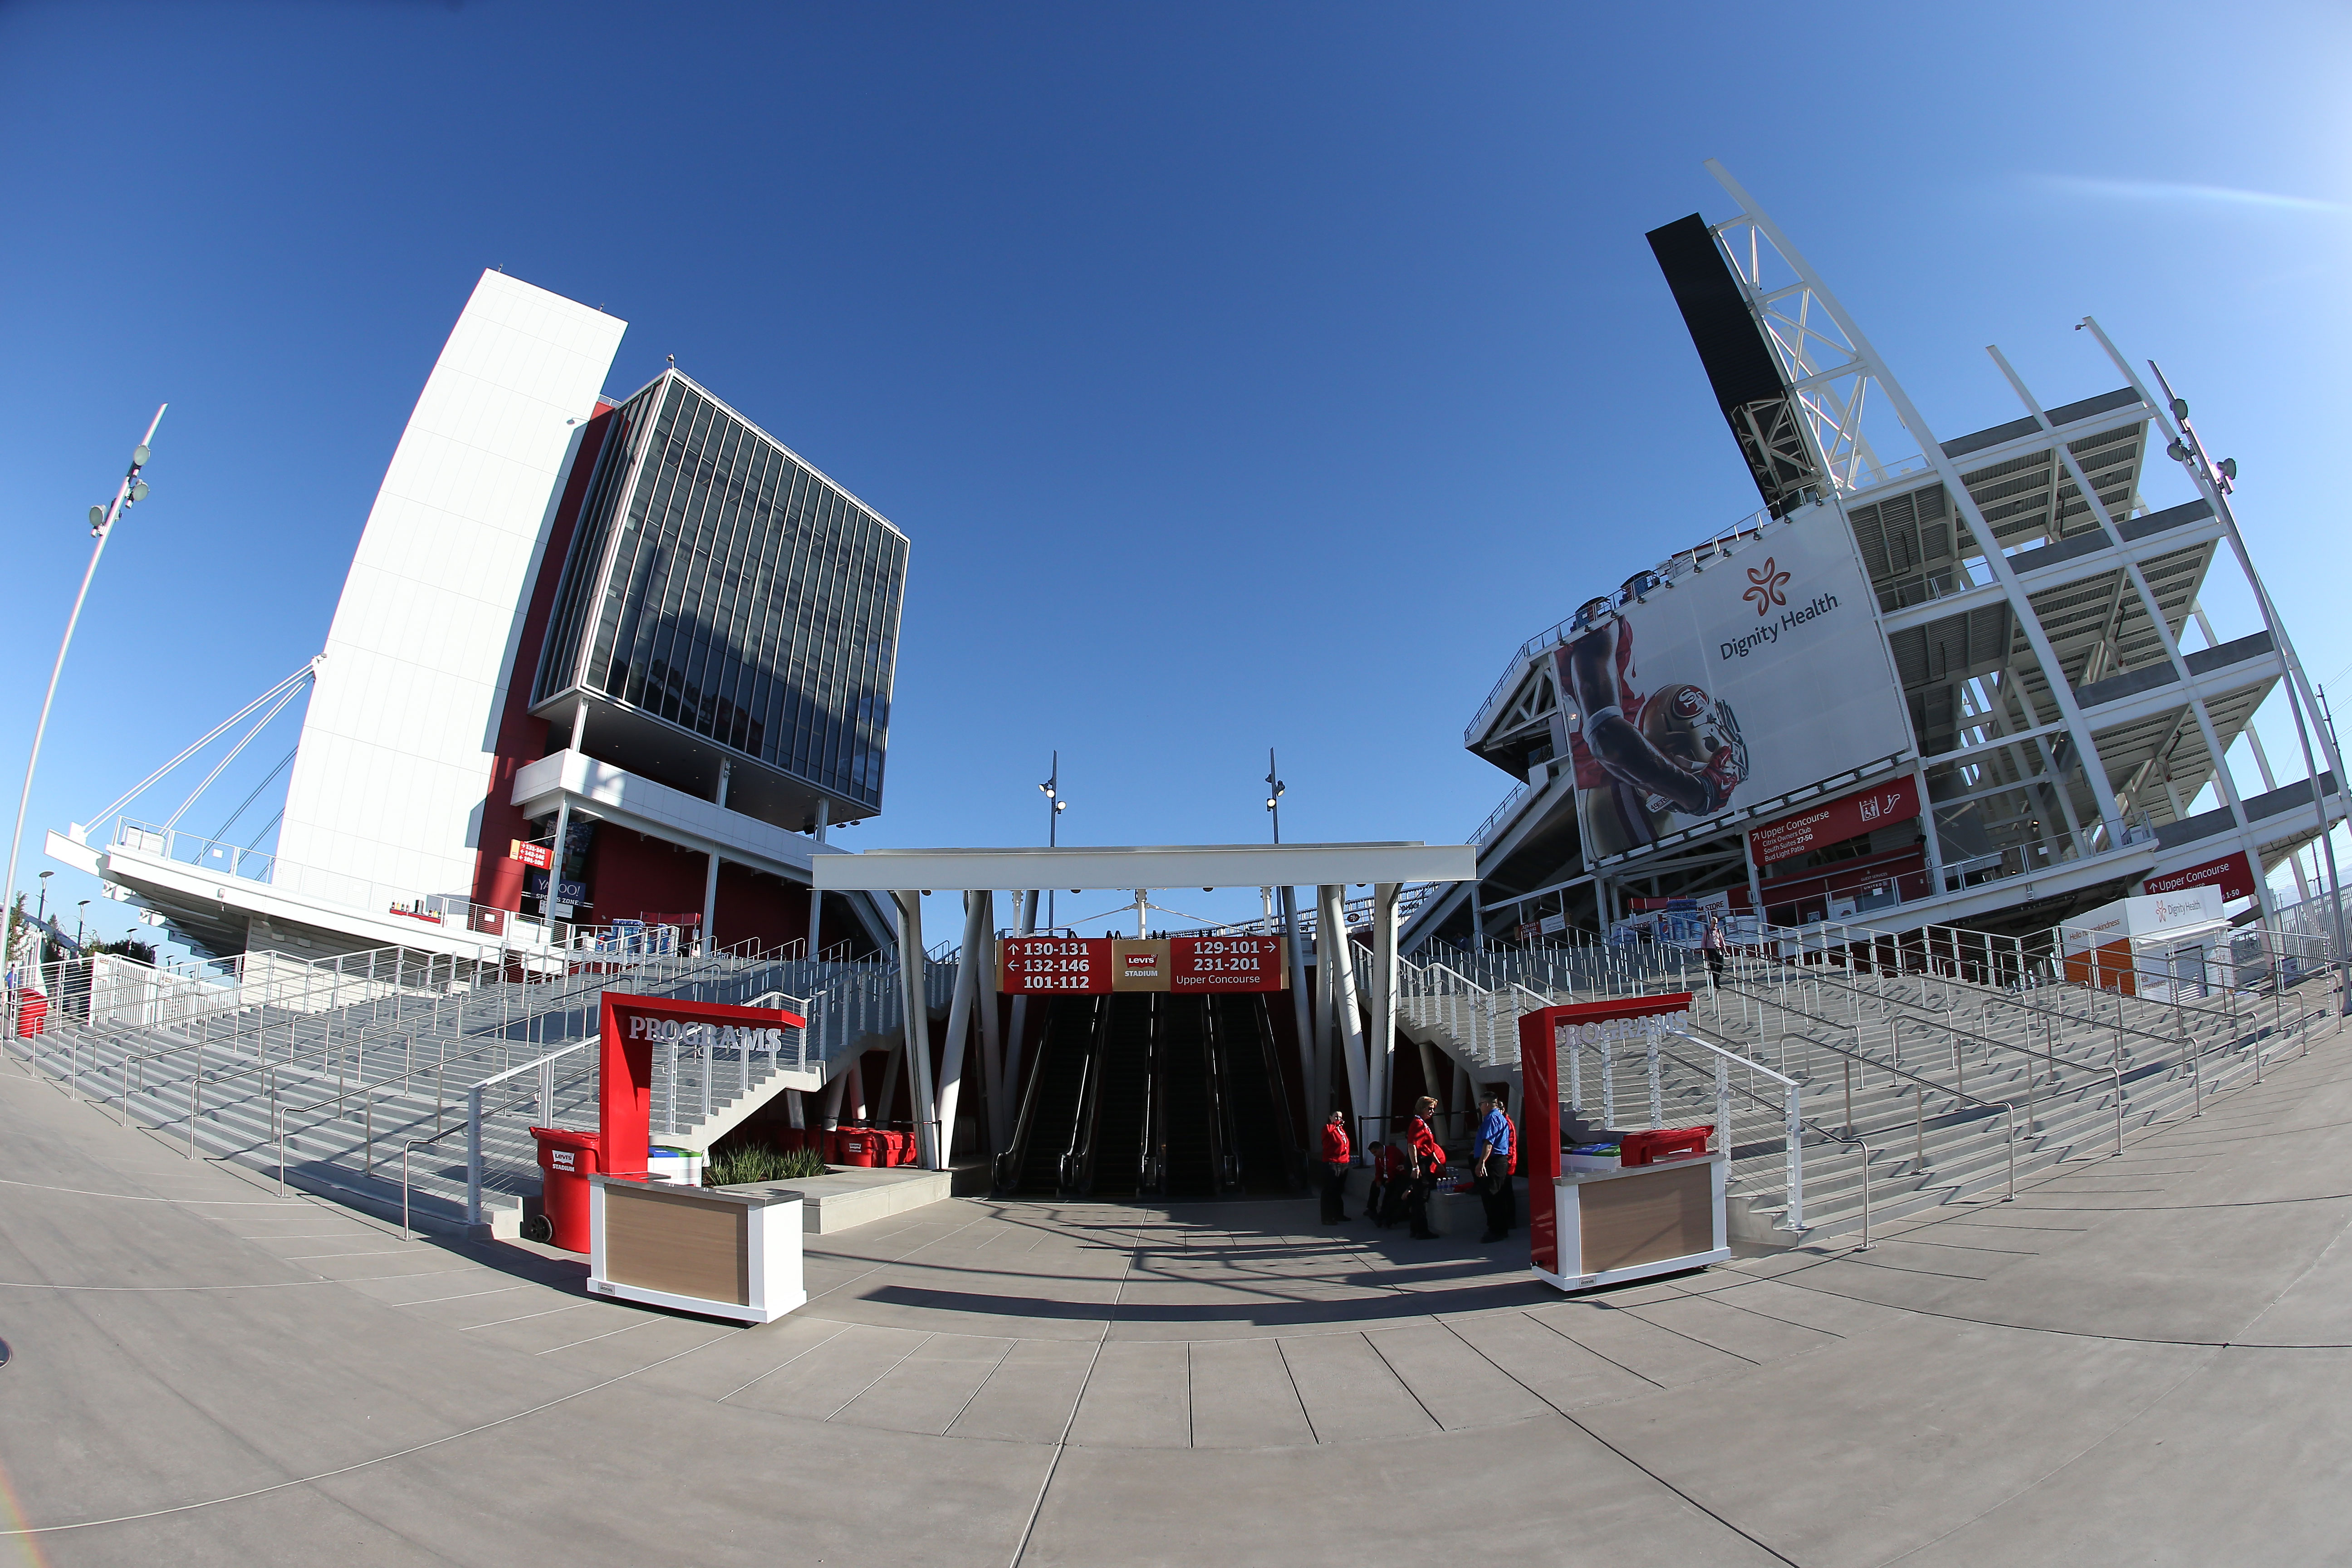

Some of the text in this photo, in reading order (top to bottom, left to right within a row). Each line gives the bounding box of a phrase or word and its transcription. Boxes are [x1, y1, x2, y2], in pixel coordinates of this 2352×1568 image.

[1720, 593, 1839, 661] Dignity Health
[1761, 810, 1830, 839] Upper Concourse
[1763, 827, 1812, 847] Citrix Owners Club
[1764, 833, 1813, 854] South Suites 27-50
[525, 844, 546, 854] 131-141
[1765, 845, 1805, 862] Bud Light Patio
[2159, 876, 2184, 891] Upper
[2186, 862, 2230, 882] Concourse
[538, 878, 580, 897] YAOO!
[2226, 888, 2239, 899] 1-50
[536, 893, 561, 902] SPOS
[1705, 900, 1724, 911] STORE
[2168, 899, 2201, 917] Dignity Health
[2069, 931, 2082, 941] Hello
[1024, 943, 1089, 955] 130-131
[1194, 941, 1259, 954] 129-101
[1024, 959, 1089, 972] 132-146
[1194, 957, 1260, 971] 231-201
[1024, 976, 1089, 988] 101-112
[1176, 975, 1260, 985] Upper Concourse
[629, 1015, 782, 1052] PROGRAMS
[552, 1163, 575, 1172] STADIUM
